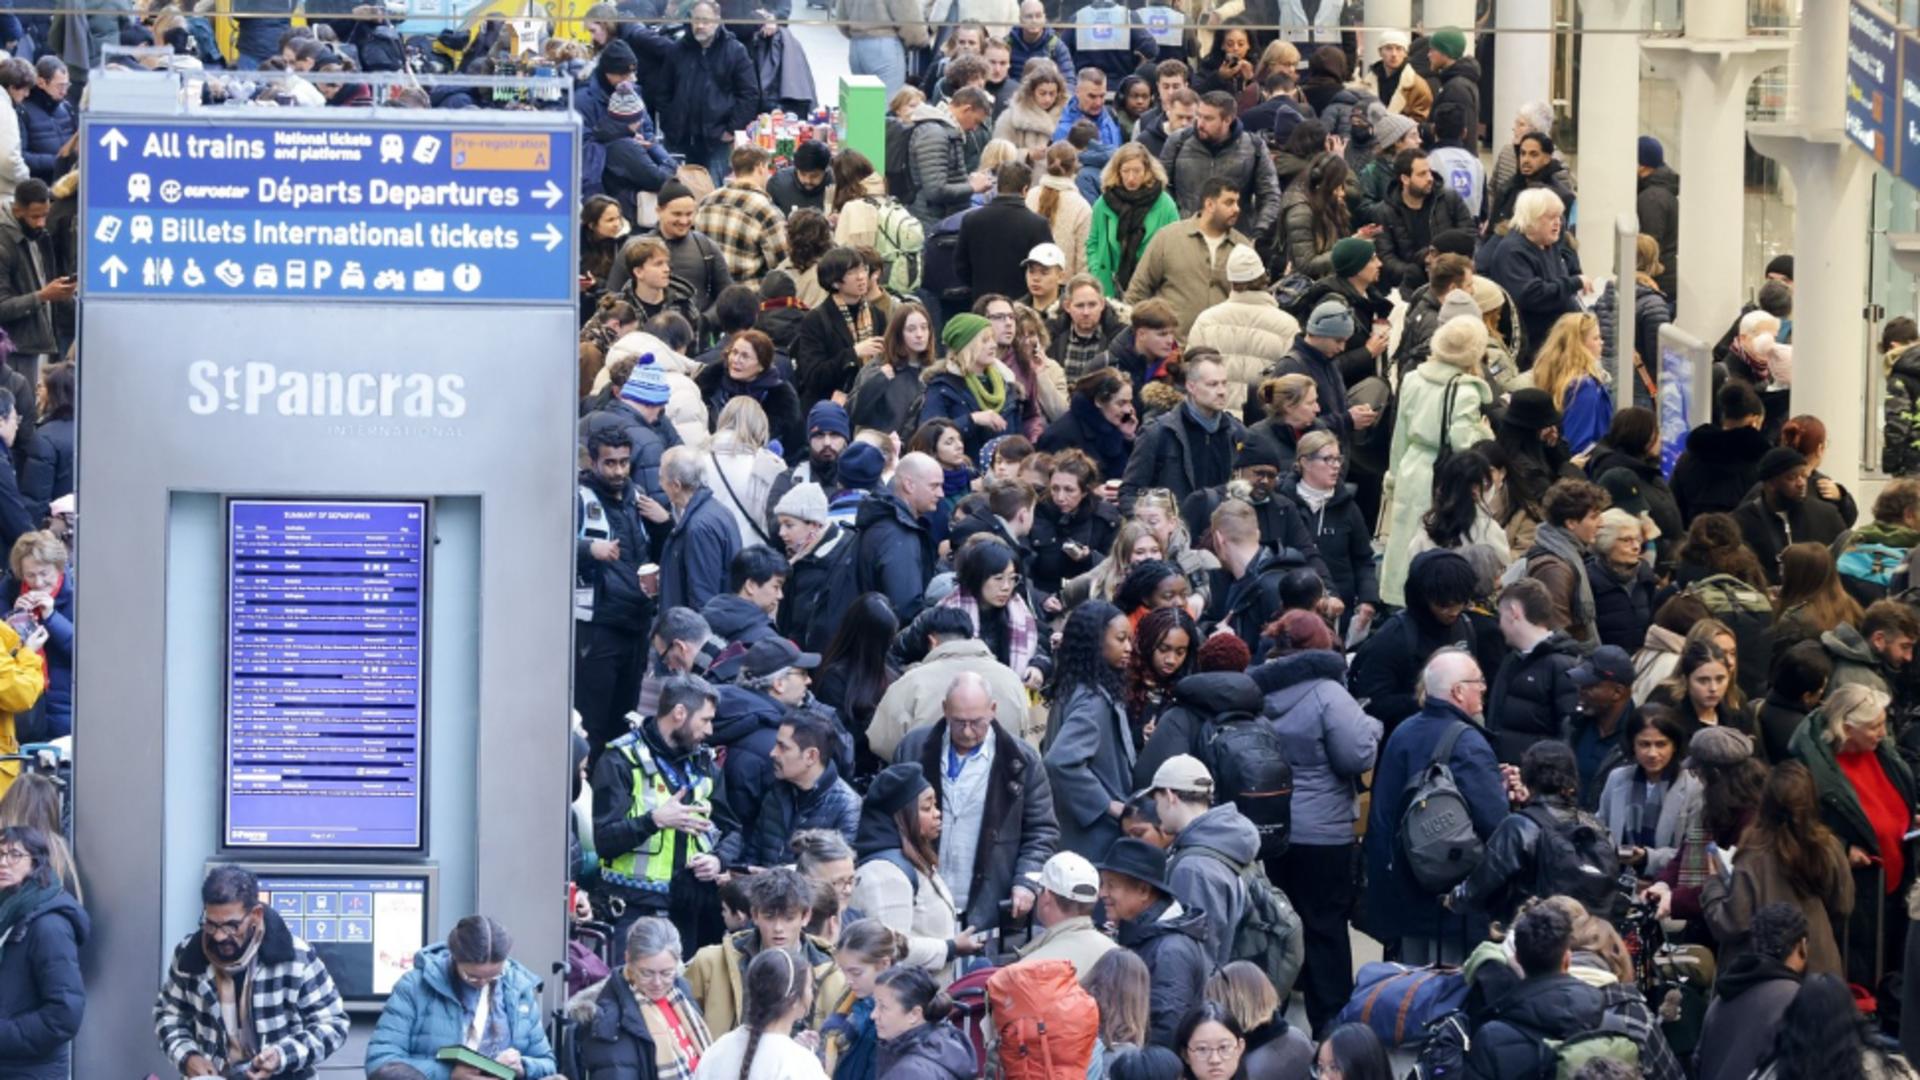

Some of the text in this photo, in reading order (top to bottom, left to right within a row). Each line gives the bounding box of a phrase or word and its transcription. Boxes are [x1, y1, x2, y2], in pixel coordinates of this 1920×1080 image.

[142, 132, 266, 161] All trains
[274, 131, 373, 147] National tickets
[454, 137, 547, 151] Pre-registration
[273, 146, 362, 162] and platforms
[534, 151, 546, 167] A
[257, 176, 520, 211] Départs Departures
[161, 217, 519, 250] Billets International tickets
[327, 424, 466, 438] INTERNATIONAL
[328, 511, 371, 520] DEPARTURES
